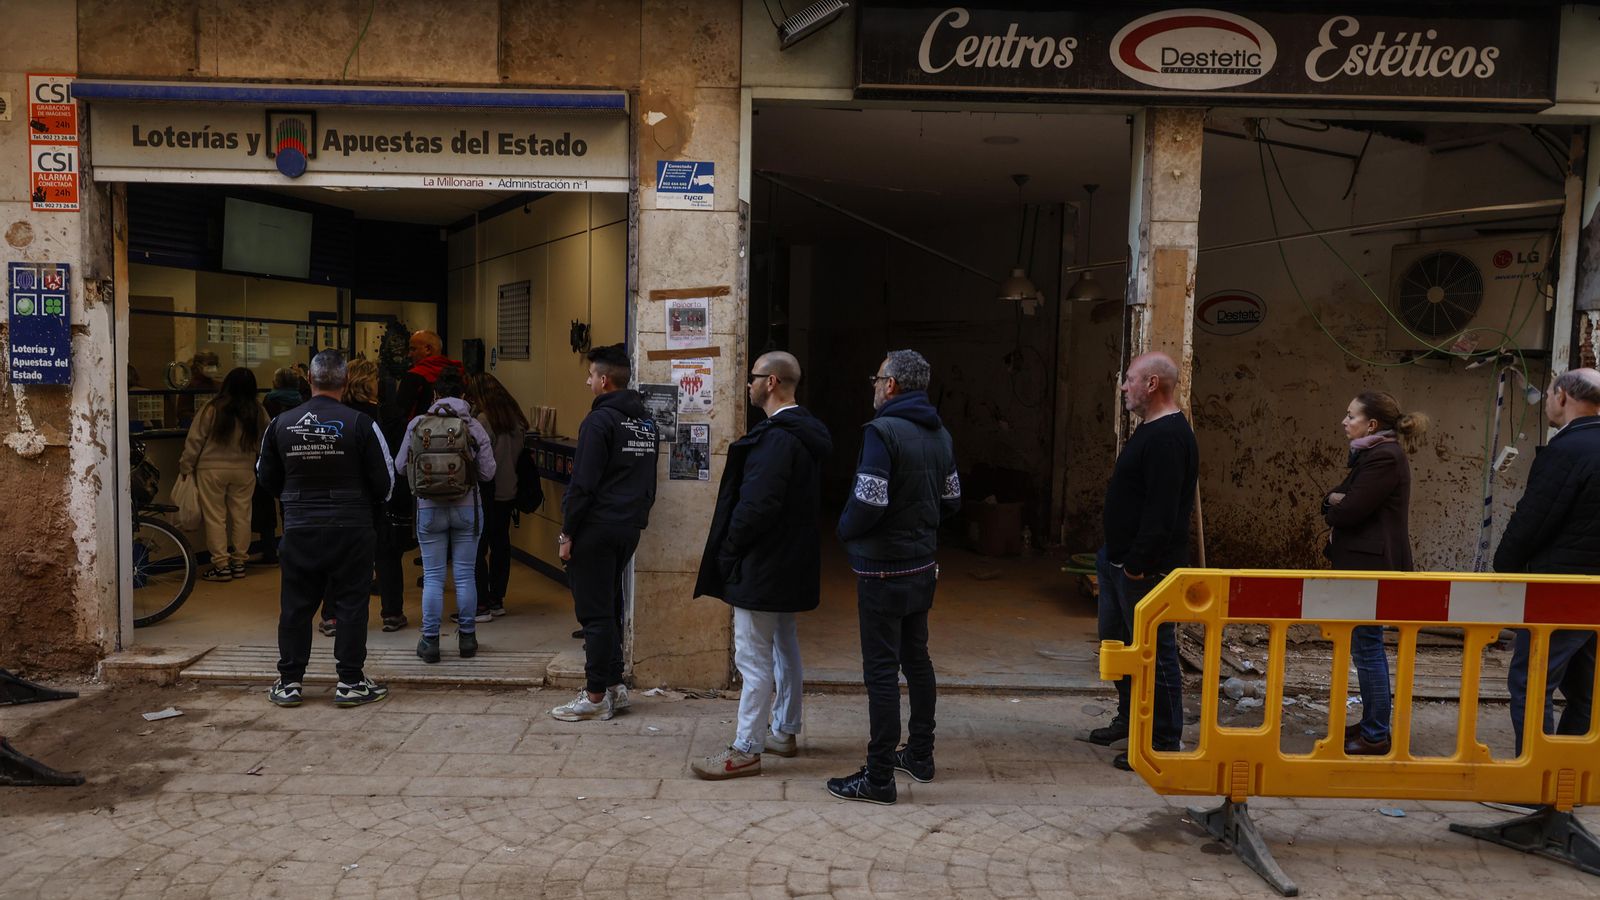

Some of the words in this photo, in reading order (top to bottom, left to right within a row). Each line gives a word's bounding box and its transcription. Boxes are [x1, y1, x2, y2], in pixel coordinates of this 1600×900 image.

[918, 6, 1079, 74] Centros
[1304, 14, 1500, 82] Estéticos
[1161, 47, 1262, 67] Destetic
[35, 83, 70, 103] CSI
[55, 120, 70, 129] 24h
[131, 124, 239, 149] Loterías
[246, 132, 261, 157] y
[322, 129, 444, 157] Apuestas
[451, 129, 489, 155] del
[498, 133, 587, 157] Estado
[37, 152, 72, 172] CSI
[423, 177, 434, 186] La
[437, 177, 484, 187] Millonaria
[497, 178, 570, 190] Administración
[55, 189, 71, 197] 24h
[1518, 252, 1539, 264] LG
[1218, 310, 1260, 320] Destetic
[12, 344, 48, 354] Loterías
[50, 347, 56, 356] y
[12, 357, 53, 368] Apuestas
[54, 358, 68, 368] del
[12, 371, 43, 380] Estado
